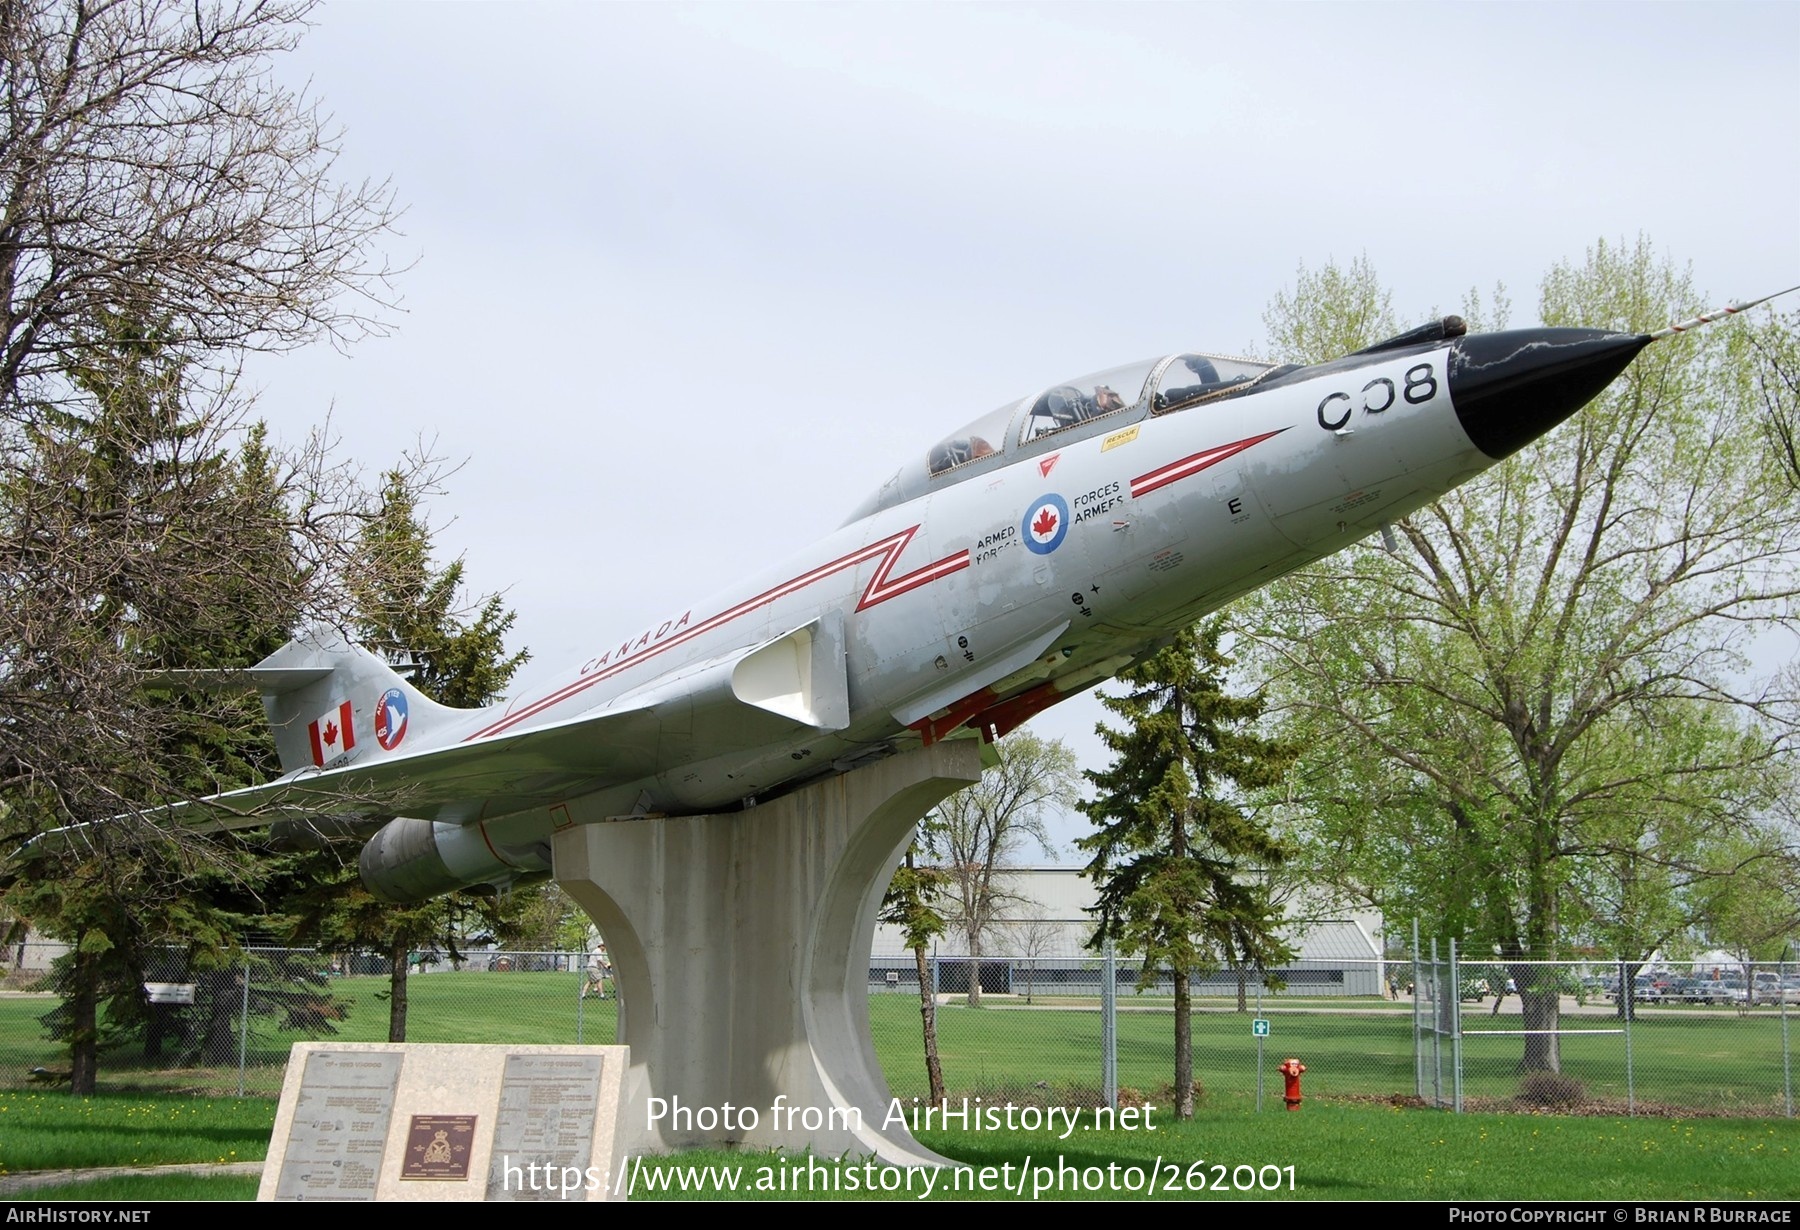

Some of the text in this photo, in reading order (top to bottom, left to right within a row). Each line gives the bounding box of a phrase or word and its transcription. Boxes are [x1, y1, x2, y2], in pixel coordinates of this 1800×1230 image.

[1106, 428, 1137, 444] RESCUE
[1074, 481, 1120, 509] FORCES
[1227, 497, 1242, 515] E
[976, 525, 1016, 549] ARMED
[580, 609, 692, 675] CANADA
